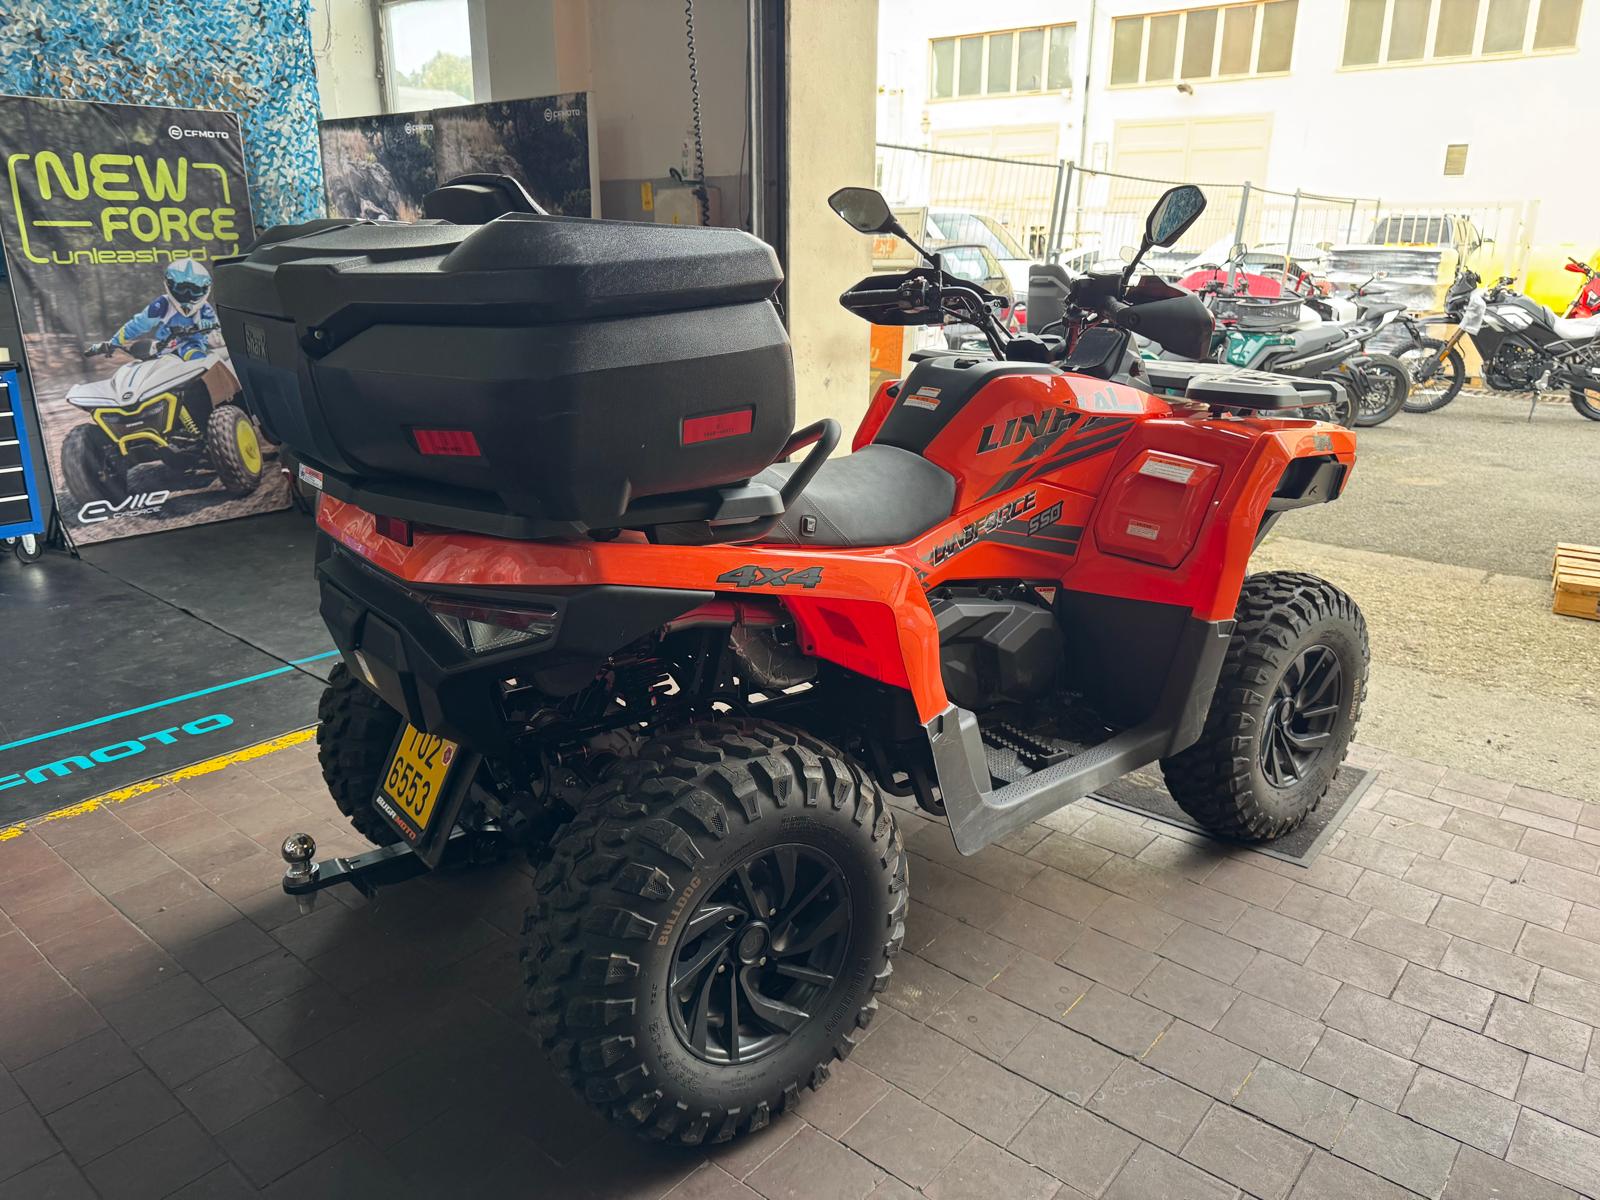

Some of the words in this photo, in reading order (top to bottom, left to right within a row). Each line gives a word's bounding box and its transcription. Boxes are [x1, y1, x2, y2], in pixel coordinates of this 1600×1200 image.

[183, 129, 230, 140] CFMOTO
[35, 150, 188, 202] NEW
[101, 206, 240, 242] FORCE
[53, 247, 208, 265] unleashed
[388, 756, 431, 816] 6553
[656, 875, 702, 946] BULLDOG
